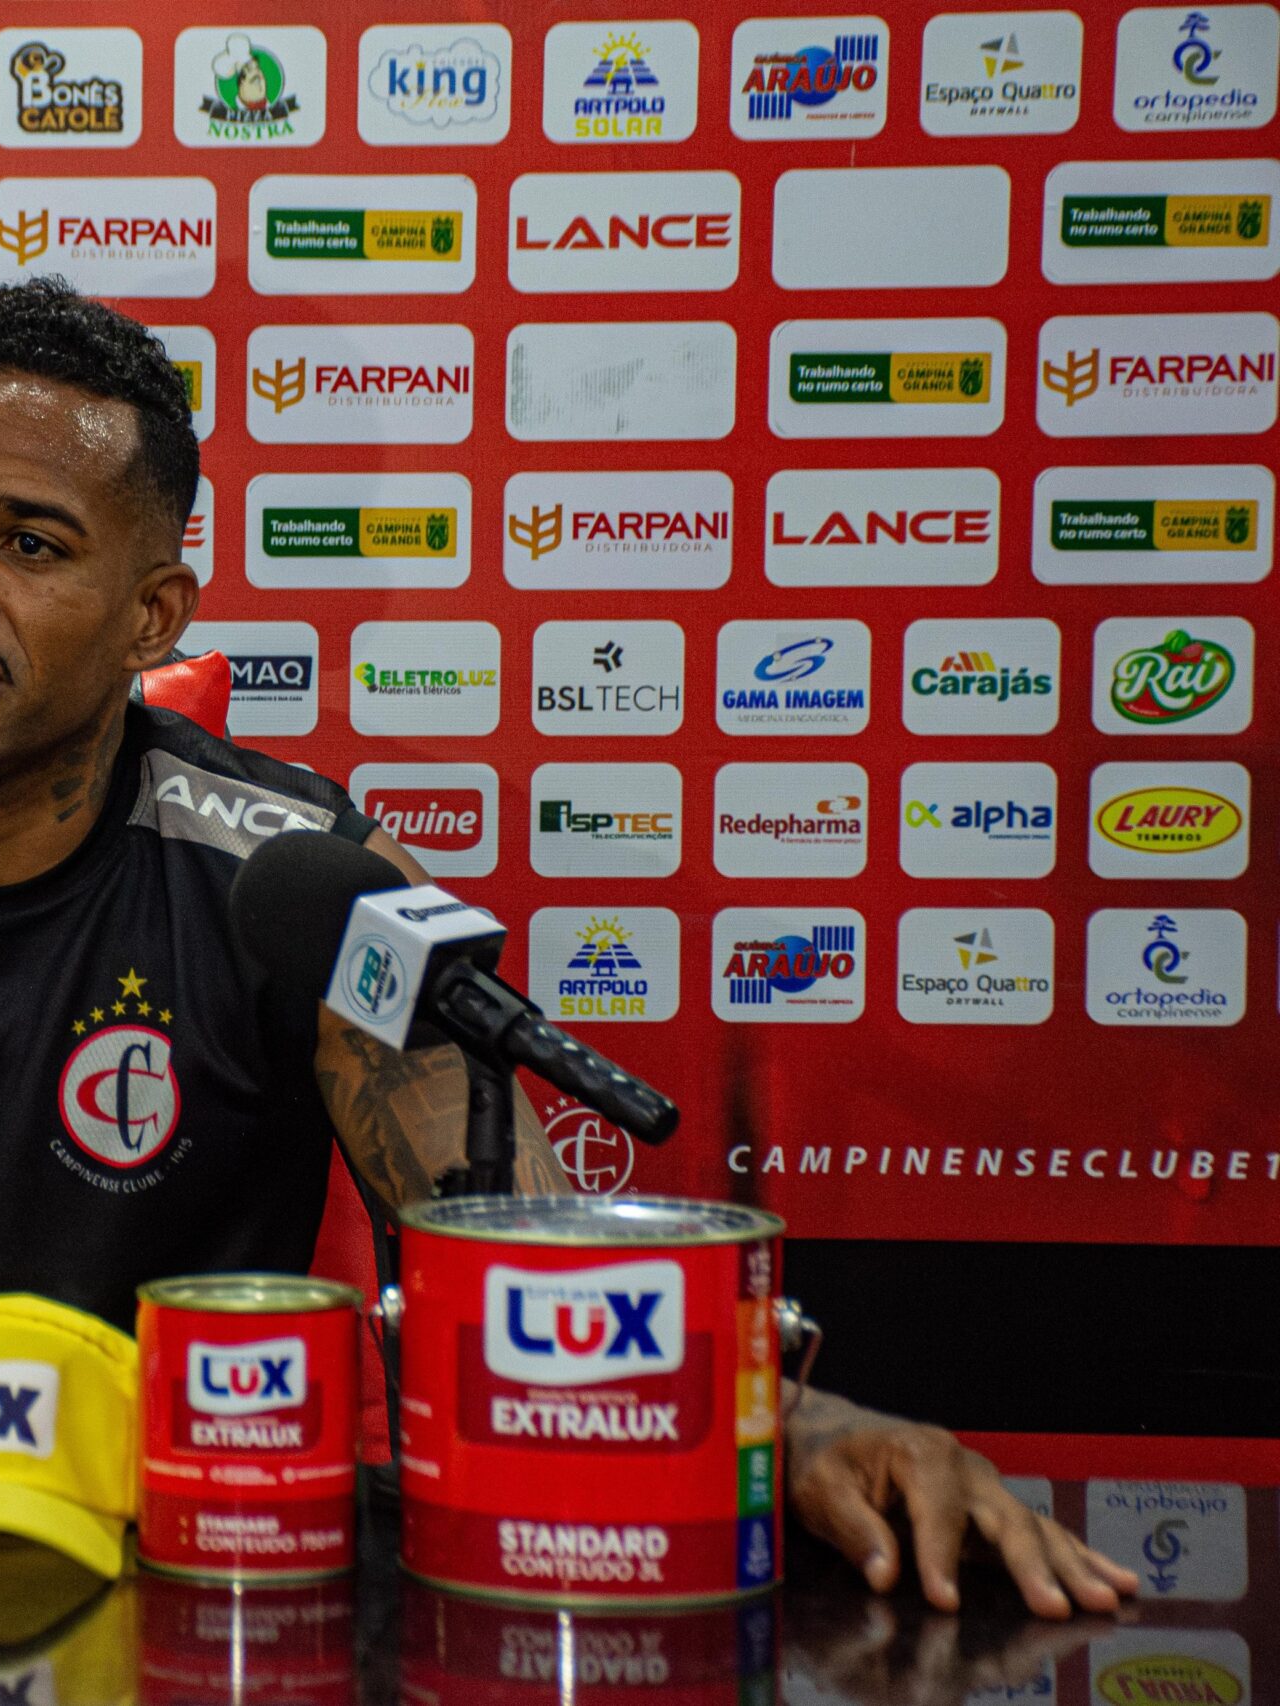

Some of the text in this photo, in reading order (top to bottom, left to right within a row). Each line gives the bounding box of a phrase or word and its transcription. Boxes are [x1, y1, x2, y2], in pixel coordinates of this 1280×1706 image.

[388, 57, 487, 106] king
[742, 60, 877, 93] ARAÚJO
[22, 68, 121, 108] BONÉS
[926, 80, 1075, 106] Espaço Quattro
[574, 97, 665, 115] ARTPOLO
[1134, 89, 1258, 111] ortopedia
[970, 105, 1029, 116] DRYWALL
[207, 121, 295, 141] NOSTRA
[575, 117, 662, 137] SOLAR
[1071, 207, 1151, 223] Trabalhando
[1172, 211, 1232, 224] CAMPINA
[58, 218, 212, 247] FARPANI
[275, 220, 350, 235] Trabalhando
[371, 225, 426, 238] CAMPINA
[516, 214, 732, 250] LANCE
[1070, 223, 1158, 237] no rumo certo
[1180, 223, 1232, 235] GRANDE
[275, 236, 357, 249] no rumo certo
[377, 238, 426, 249] GRANDE
[71, 248, 197, 260] DISTRIBUIDORA
[798, 365, 875, 379] Trabalhando
[897, 368, 954, 381] CAMPINA
[1110, 353, 1275, 384] FARPANI
[315, 366, 470, 393] FARPANI
[798, 379, 883, 392] no rumo certo
[903, 381, 954, 392] GRANDE
[1123, 384, 1258, 399] DISTRIBUIDORA
[328, 395, 455, 407] DISTRIBUIDORA
[271, 519, 346, 534] Trabalhando
[572, 511, 728, 540] FARPANI
[773, 510, 991, 546] LANCE
[1060, 512, 1140, 527] Trabalhando
[1161, 515, 1220, 528] CAMPINA
[366, 523, 421, 535] CAMPINA
[1060, 526, 1147, 540] no rumo certo
[1167, 528, 1220, 540] GRANDE
[271, 534, 353, 547] no rumo certo
[372, 535, 421, 546] GRANDE
[585, 541, 713, 553] DISTRIBUIDORA
[229, 661, 304, 686] MAQ
[379, 669, 496, 688] ELETROLUZ
[1116, 650, 1227, 709] Rai
[379, 684, 461, 695] Materiais Elétricos
[911, 667, 1052, 702] Carajás
[538, 685, 679, 711] BSLTECH
[722, 689, 864, 709] GAMA IMAGEM
[374, 802, 477, 841] Iquine
[720, 813, 861, 839] Redepharma
[951, 802, 1052, 834] alpha
[1115, 804, 1224, 832] LAURY
[1136, 833, 1202, 843] TEMPEROS
[734, 938, 787, 952] QUÍMICA
[722, 948, 855, 979] ARAÚJO
[559, 979, 647, 995] ARTPOLO
[902, 973, 1050, 995] Espaço Quattro
[1106, 986, 1226, 1007] ortopedia
[559, 997, 645, 1015] SOLAR
[50, 1137, 193, 1193] CAMPINENSE CLUBE 1915
[491, 1397, 678, 1441] EXTRALUX
[191, 1420, 302, 1448] EXTRALUX
[499, 1519, 668, 1560] STANDARD
